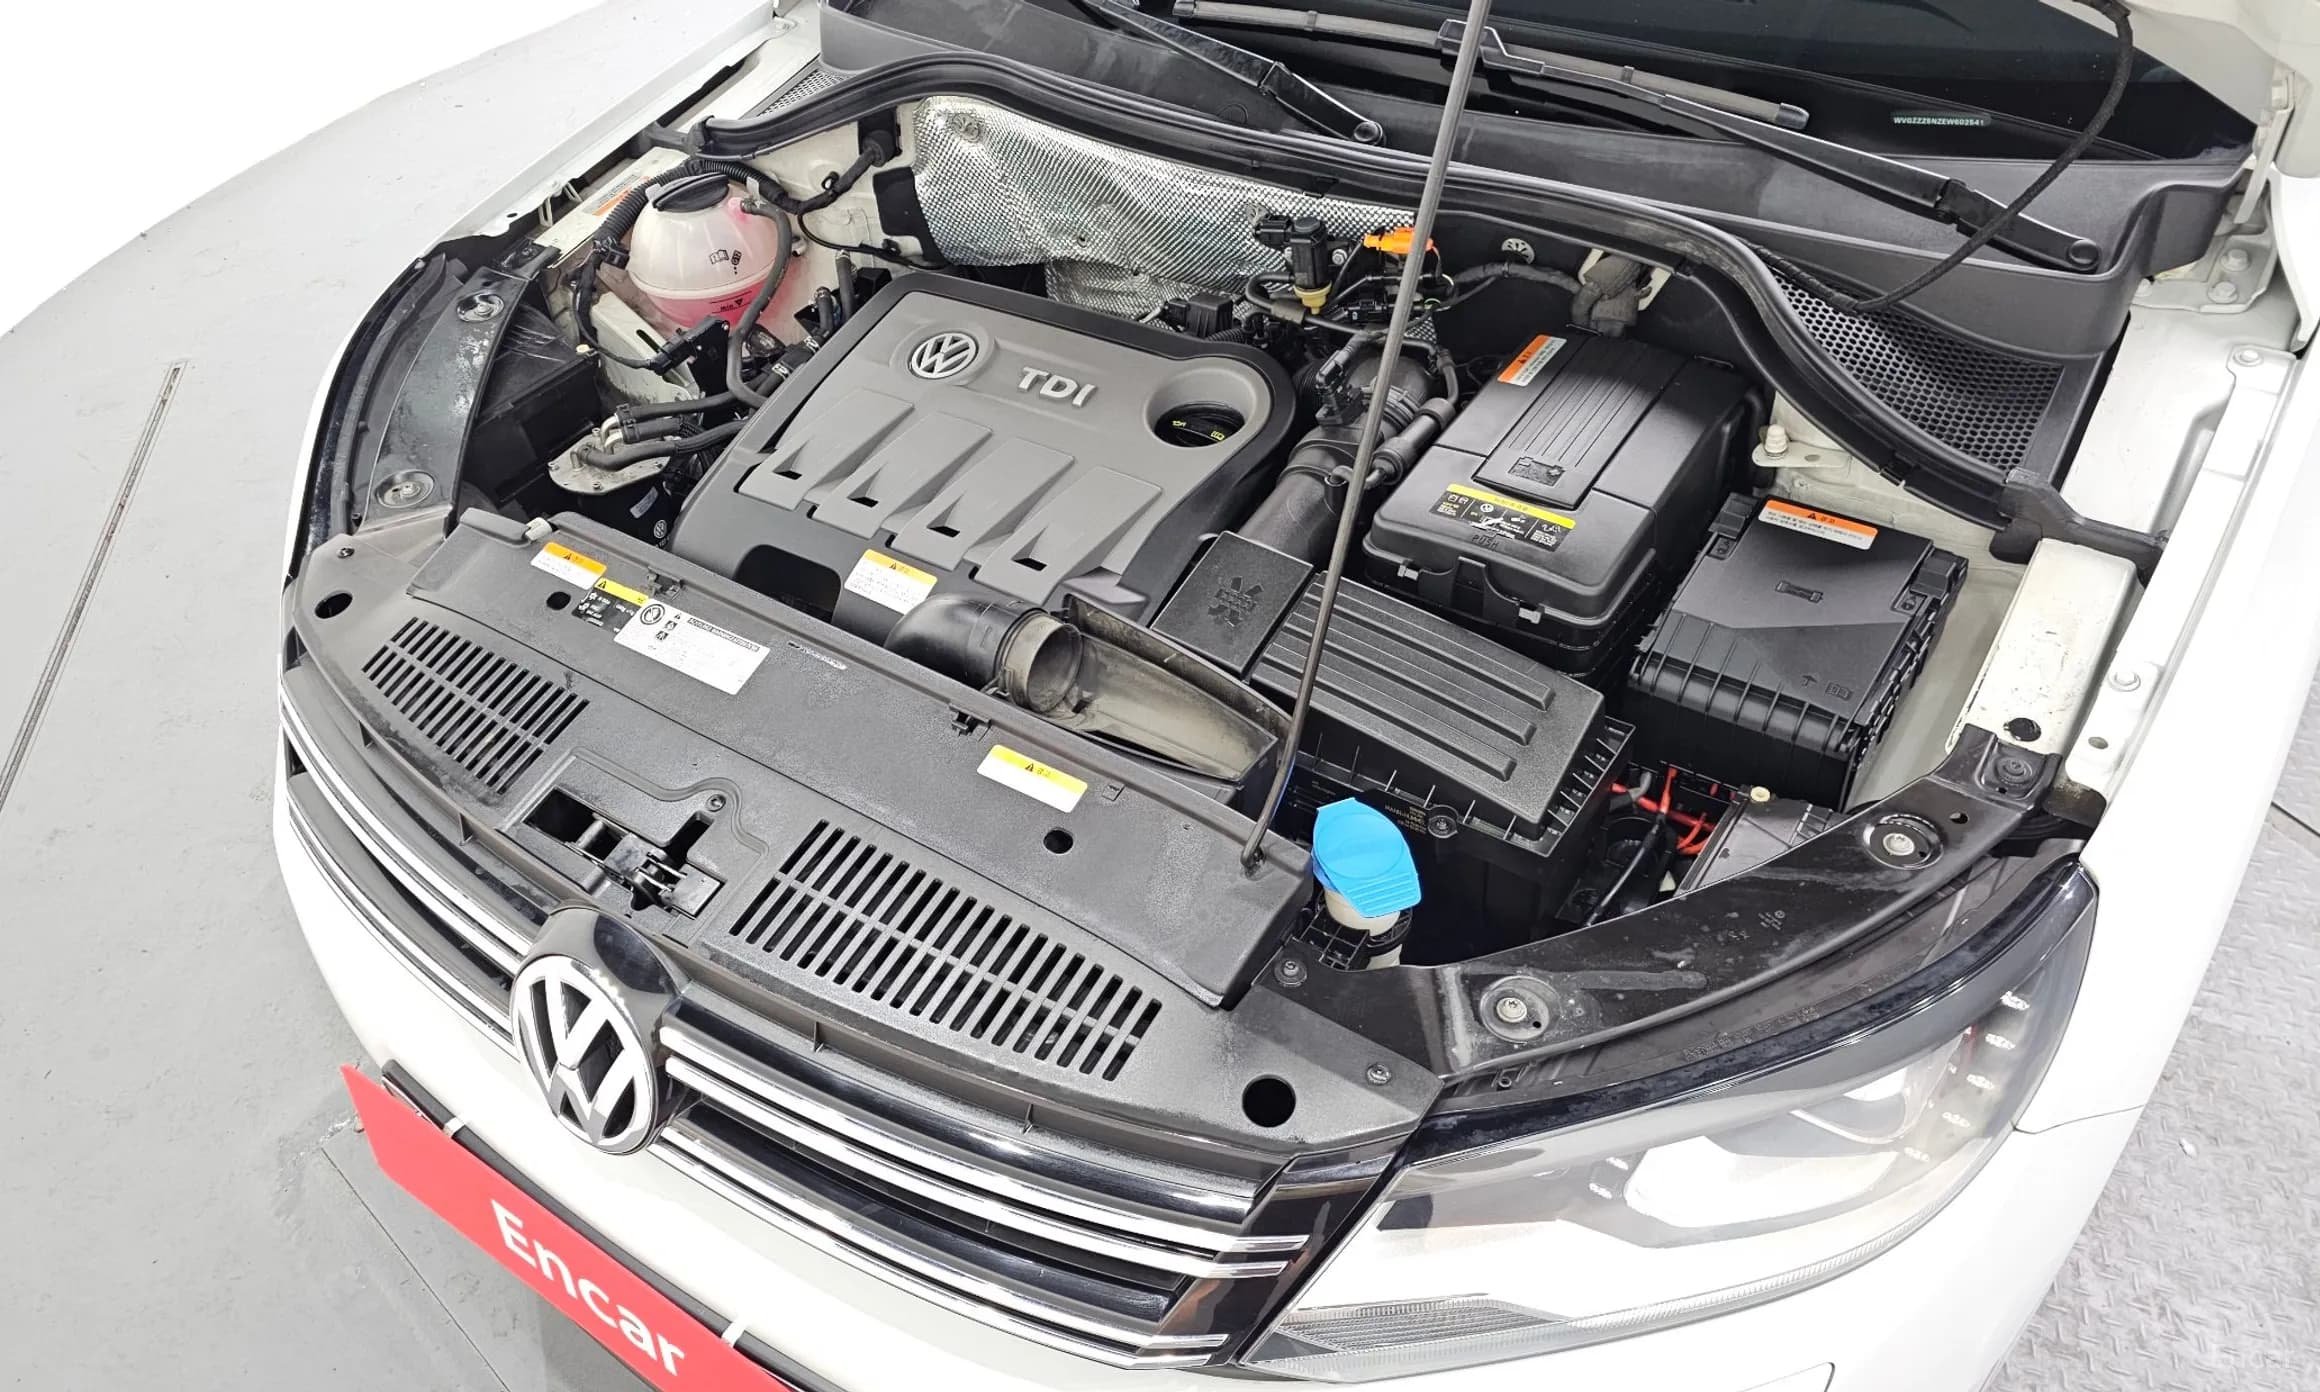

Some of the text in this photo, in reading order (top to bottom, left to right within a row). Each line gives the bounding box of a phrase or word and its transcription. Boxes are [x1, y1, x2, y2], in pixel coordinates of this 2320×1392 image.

[1018, 366, 1097, 408] TDI
[1472, 533, 1499, 550] PUSH
[490, 1199, 685, 1377] Encar
